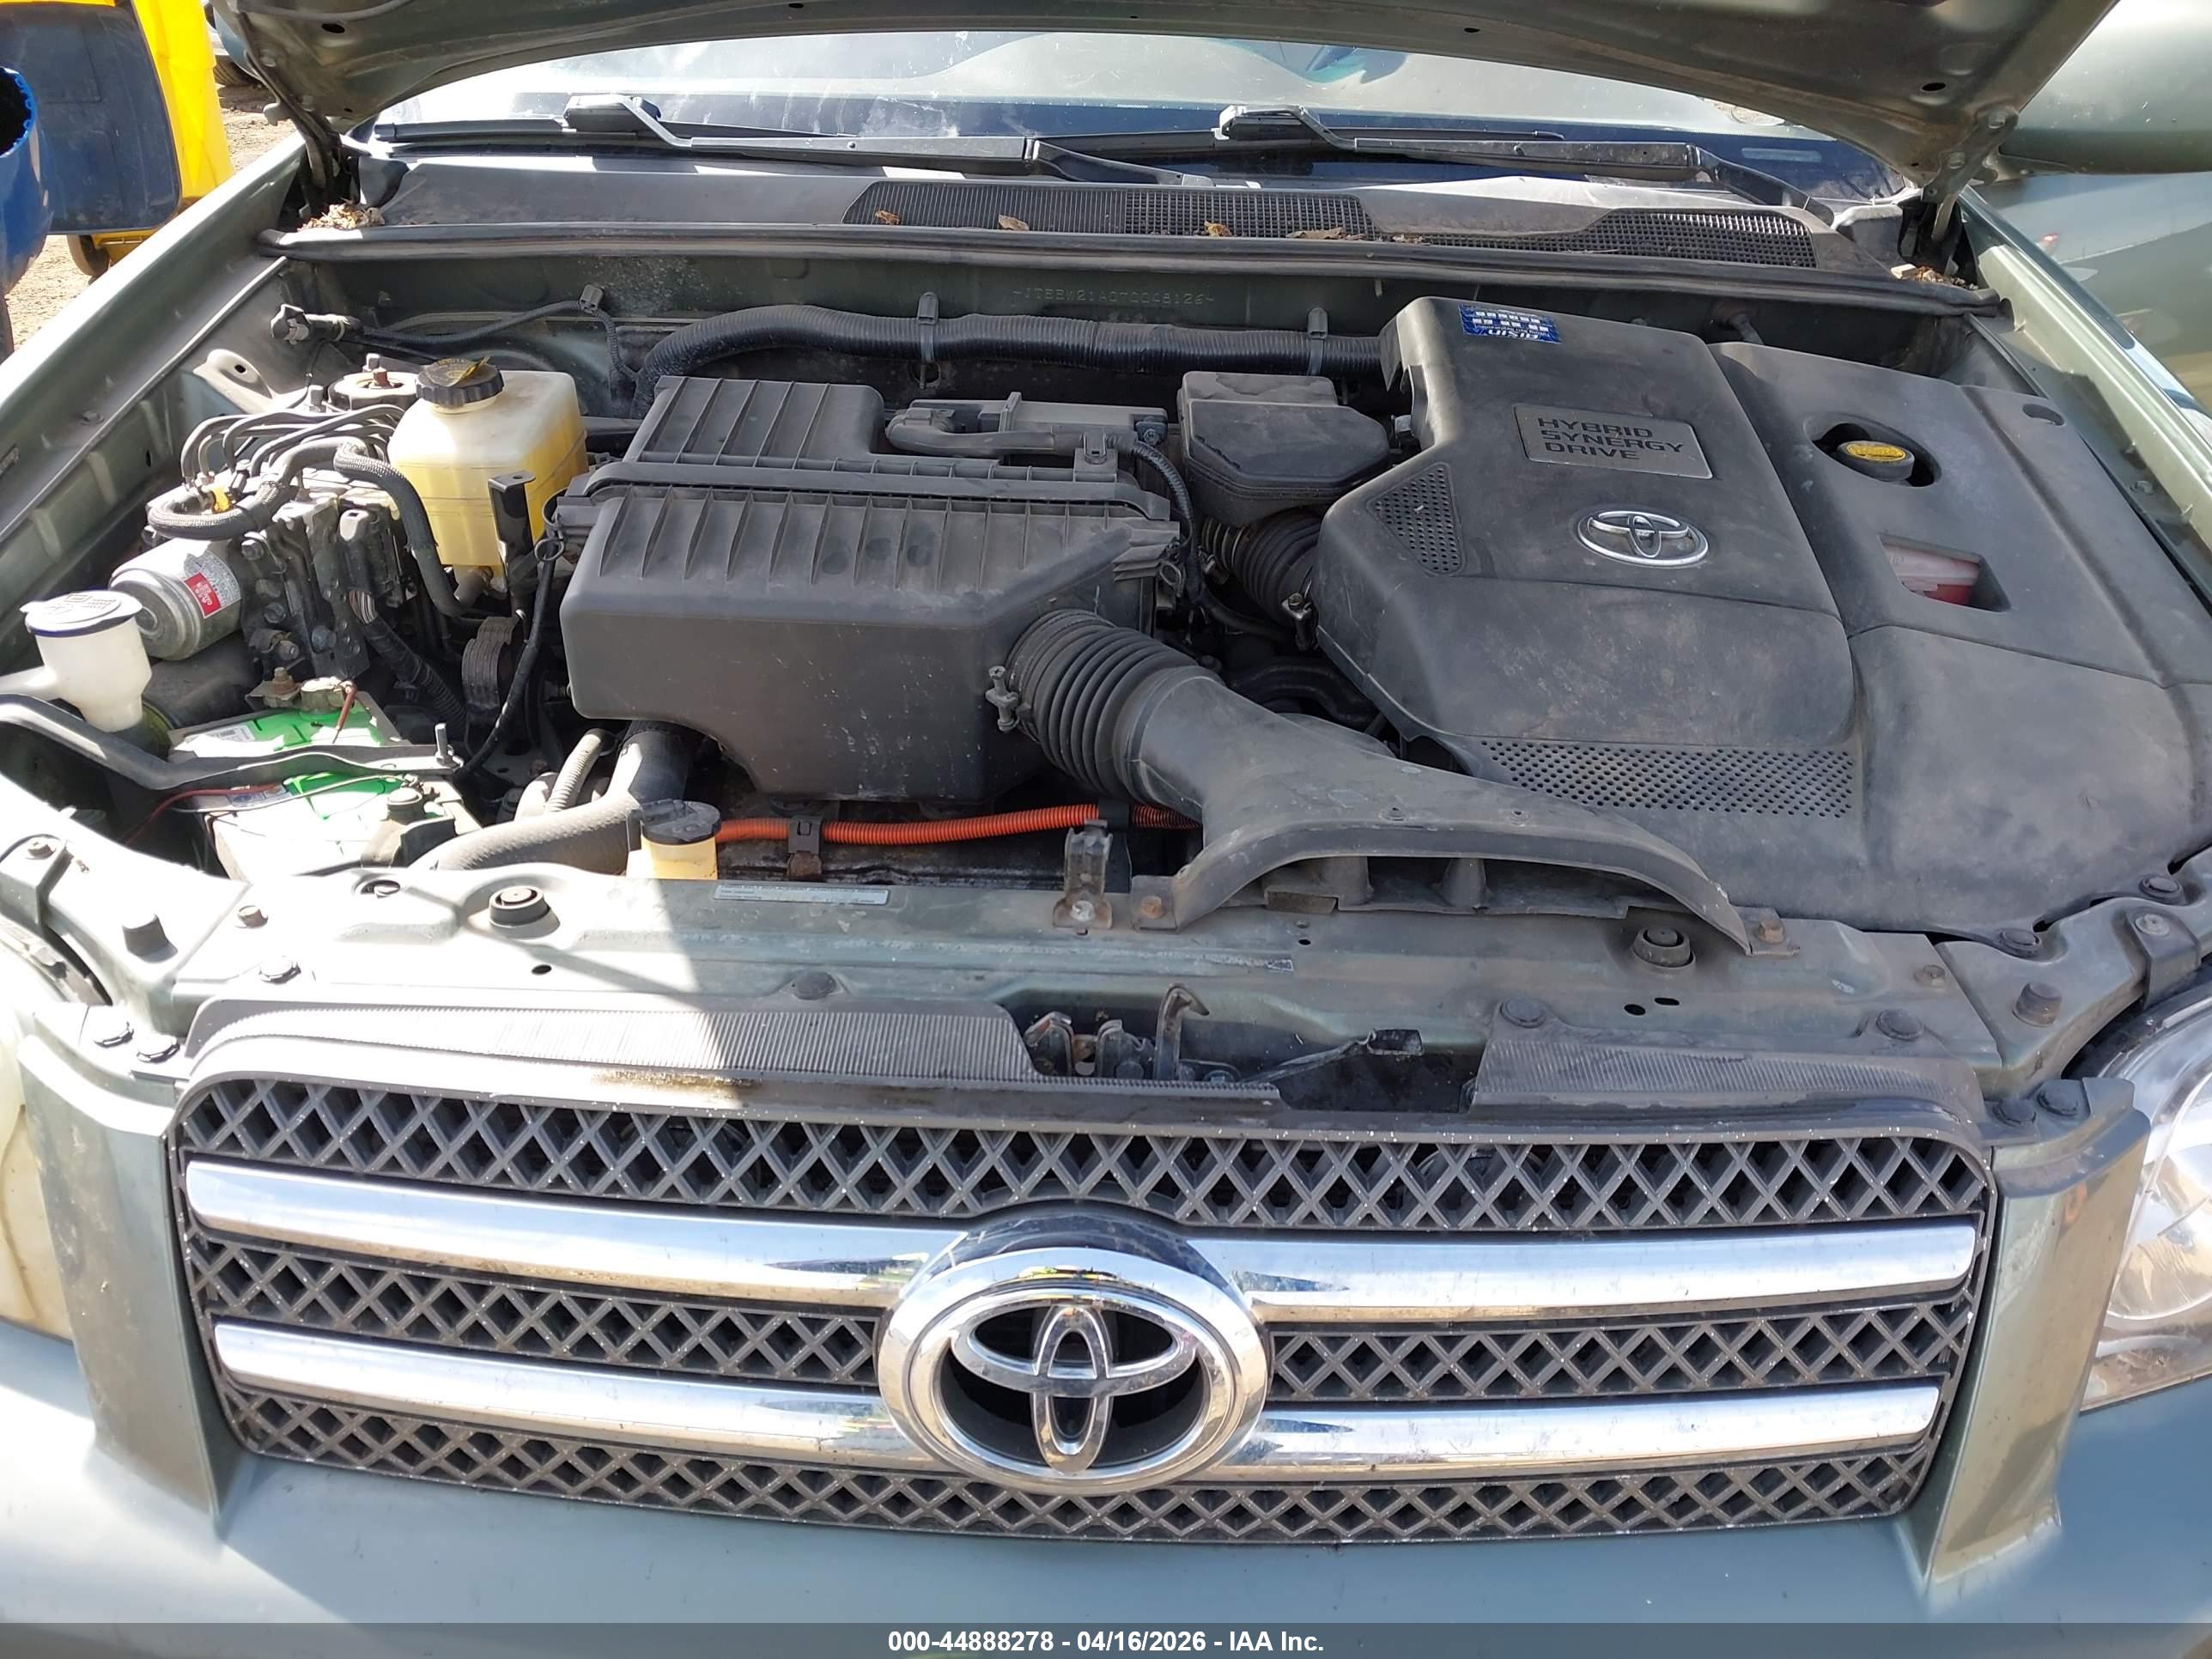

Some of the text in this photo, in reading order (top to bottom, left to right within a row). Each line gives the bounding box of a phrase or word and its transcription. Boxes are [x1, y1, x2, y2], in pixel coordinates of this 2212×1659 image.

[1538, 417, 1653, 438] HYBRID
[1540, 429, 1684, 453] SYNERGY
[1544, 442, 1639, 460] DRIVE
